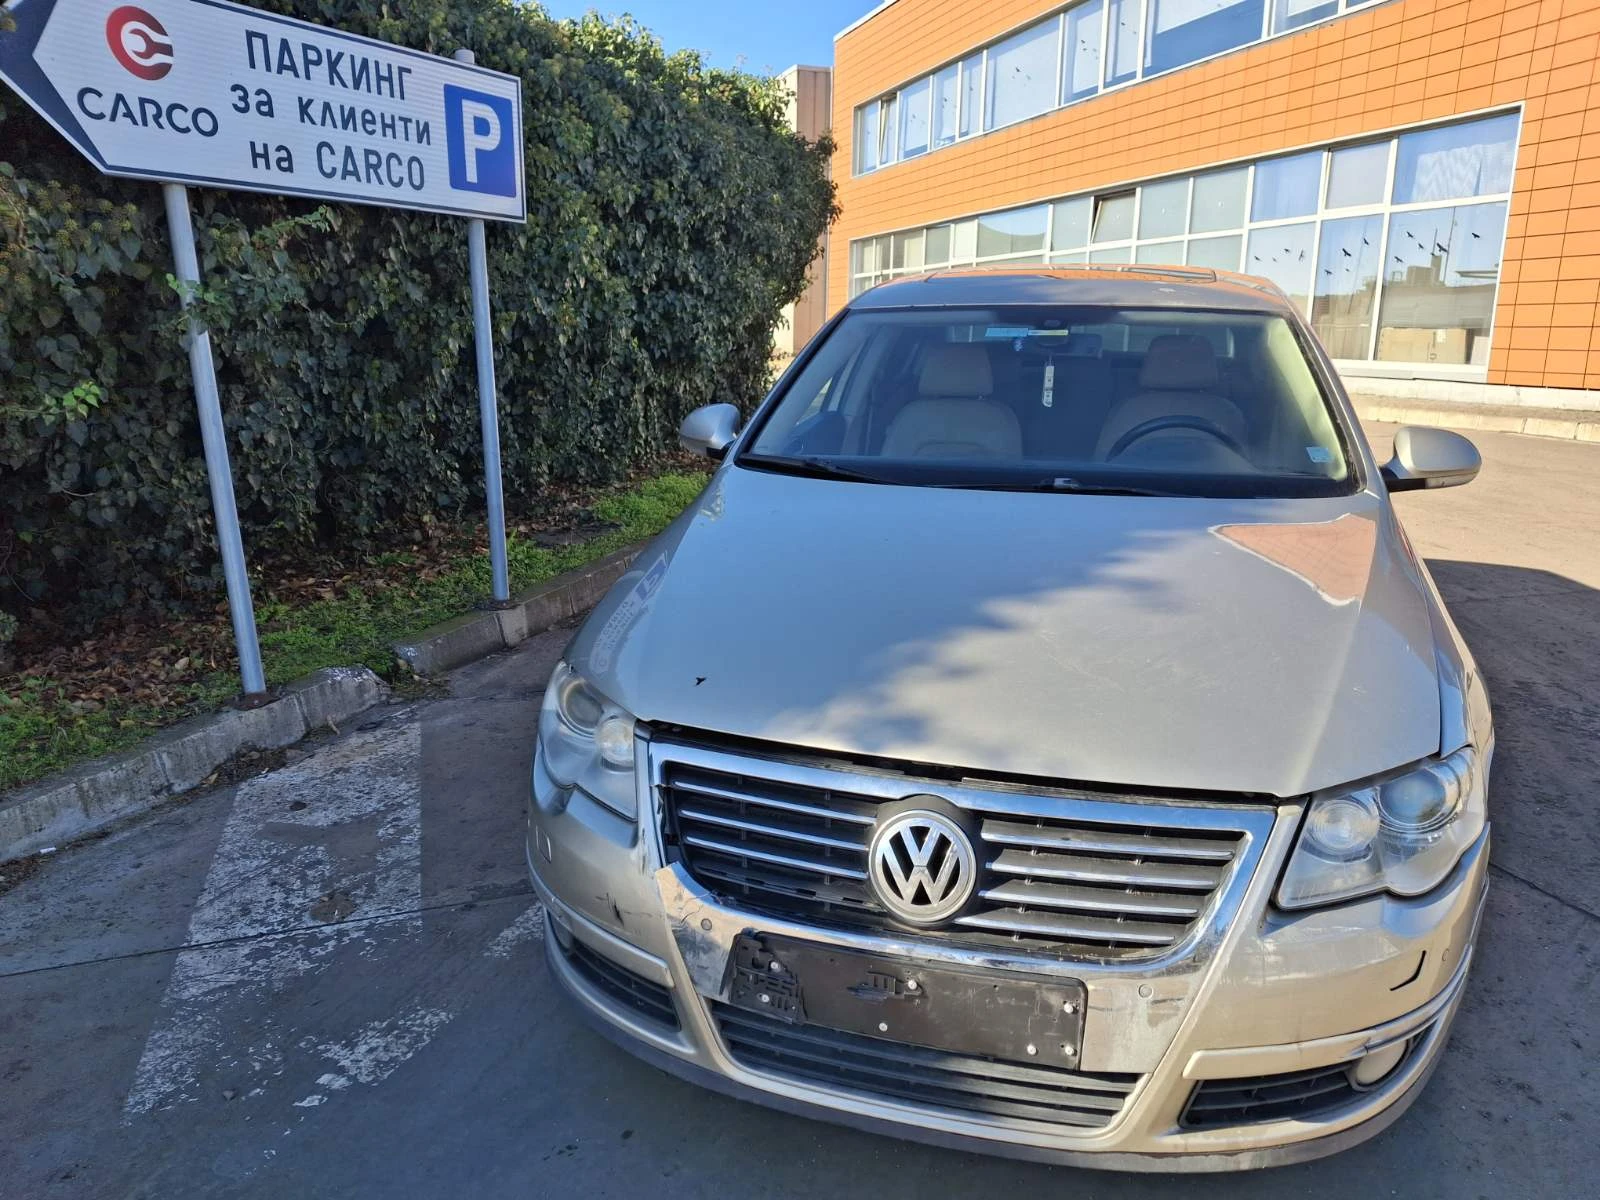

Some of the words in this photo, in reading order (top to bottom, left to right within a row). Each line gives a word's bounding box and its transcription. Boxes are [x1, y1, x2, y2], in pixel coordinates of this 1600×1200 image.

[245, 29, 412, 100] ПАРКИНГ
[77, 87, 219, 137] CARCO
[230, 84, 275, 118] за
[298, 96, 431, 146] клиенти
[461, 99, 501, 184] P
[250, 141, 294, 173] на
[316, 141, 425, 191] CARCO
[875, 816, 970, 915] VW
